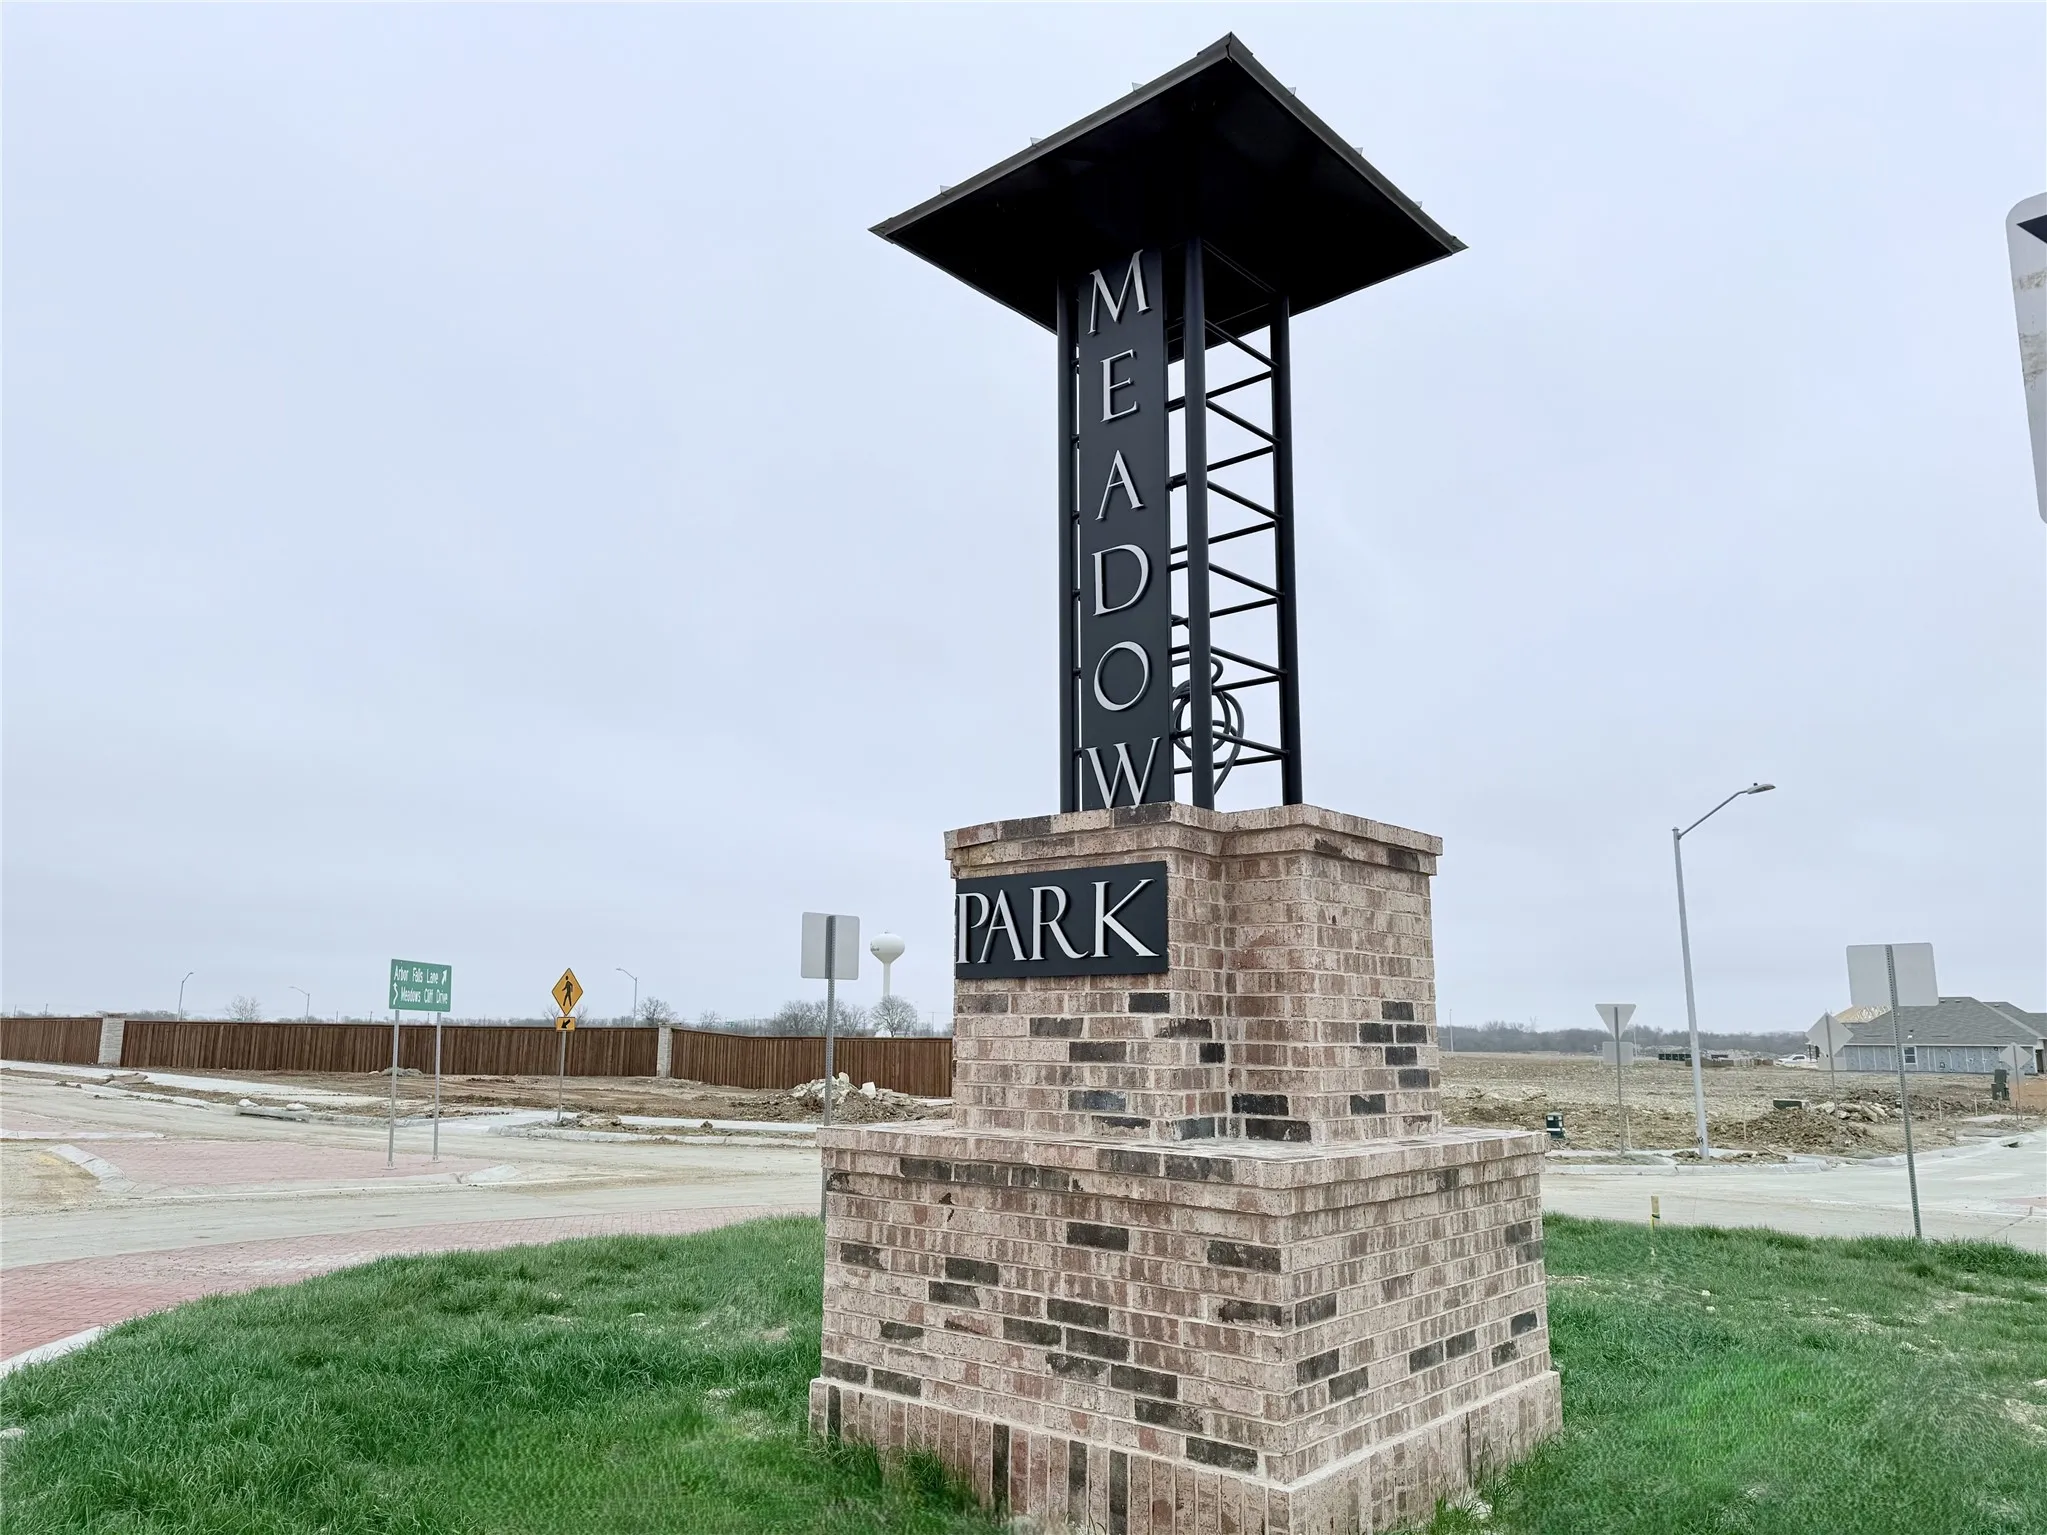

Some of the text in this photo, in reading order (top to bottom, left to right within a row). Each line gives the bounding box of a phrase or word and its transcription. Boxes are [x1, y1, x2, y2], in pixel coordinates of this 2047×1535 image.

[1085, 249, 1161, 809] MEADOW
[956, 878, 1160, 964] PARK
[394, 965, 438, 984] Arbor Falls Lane
[400, 987, 448, 1004] Meadows Cliff Drive
